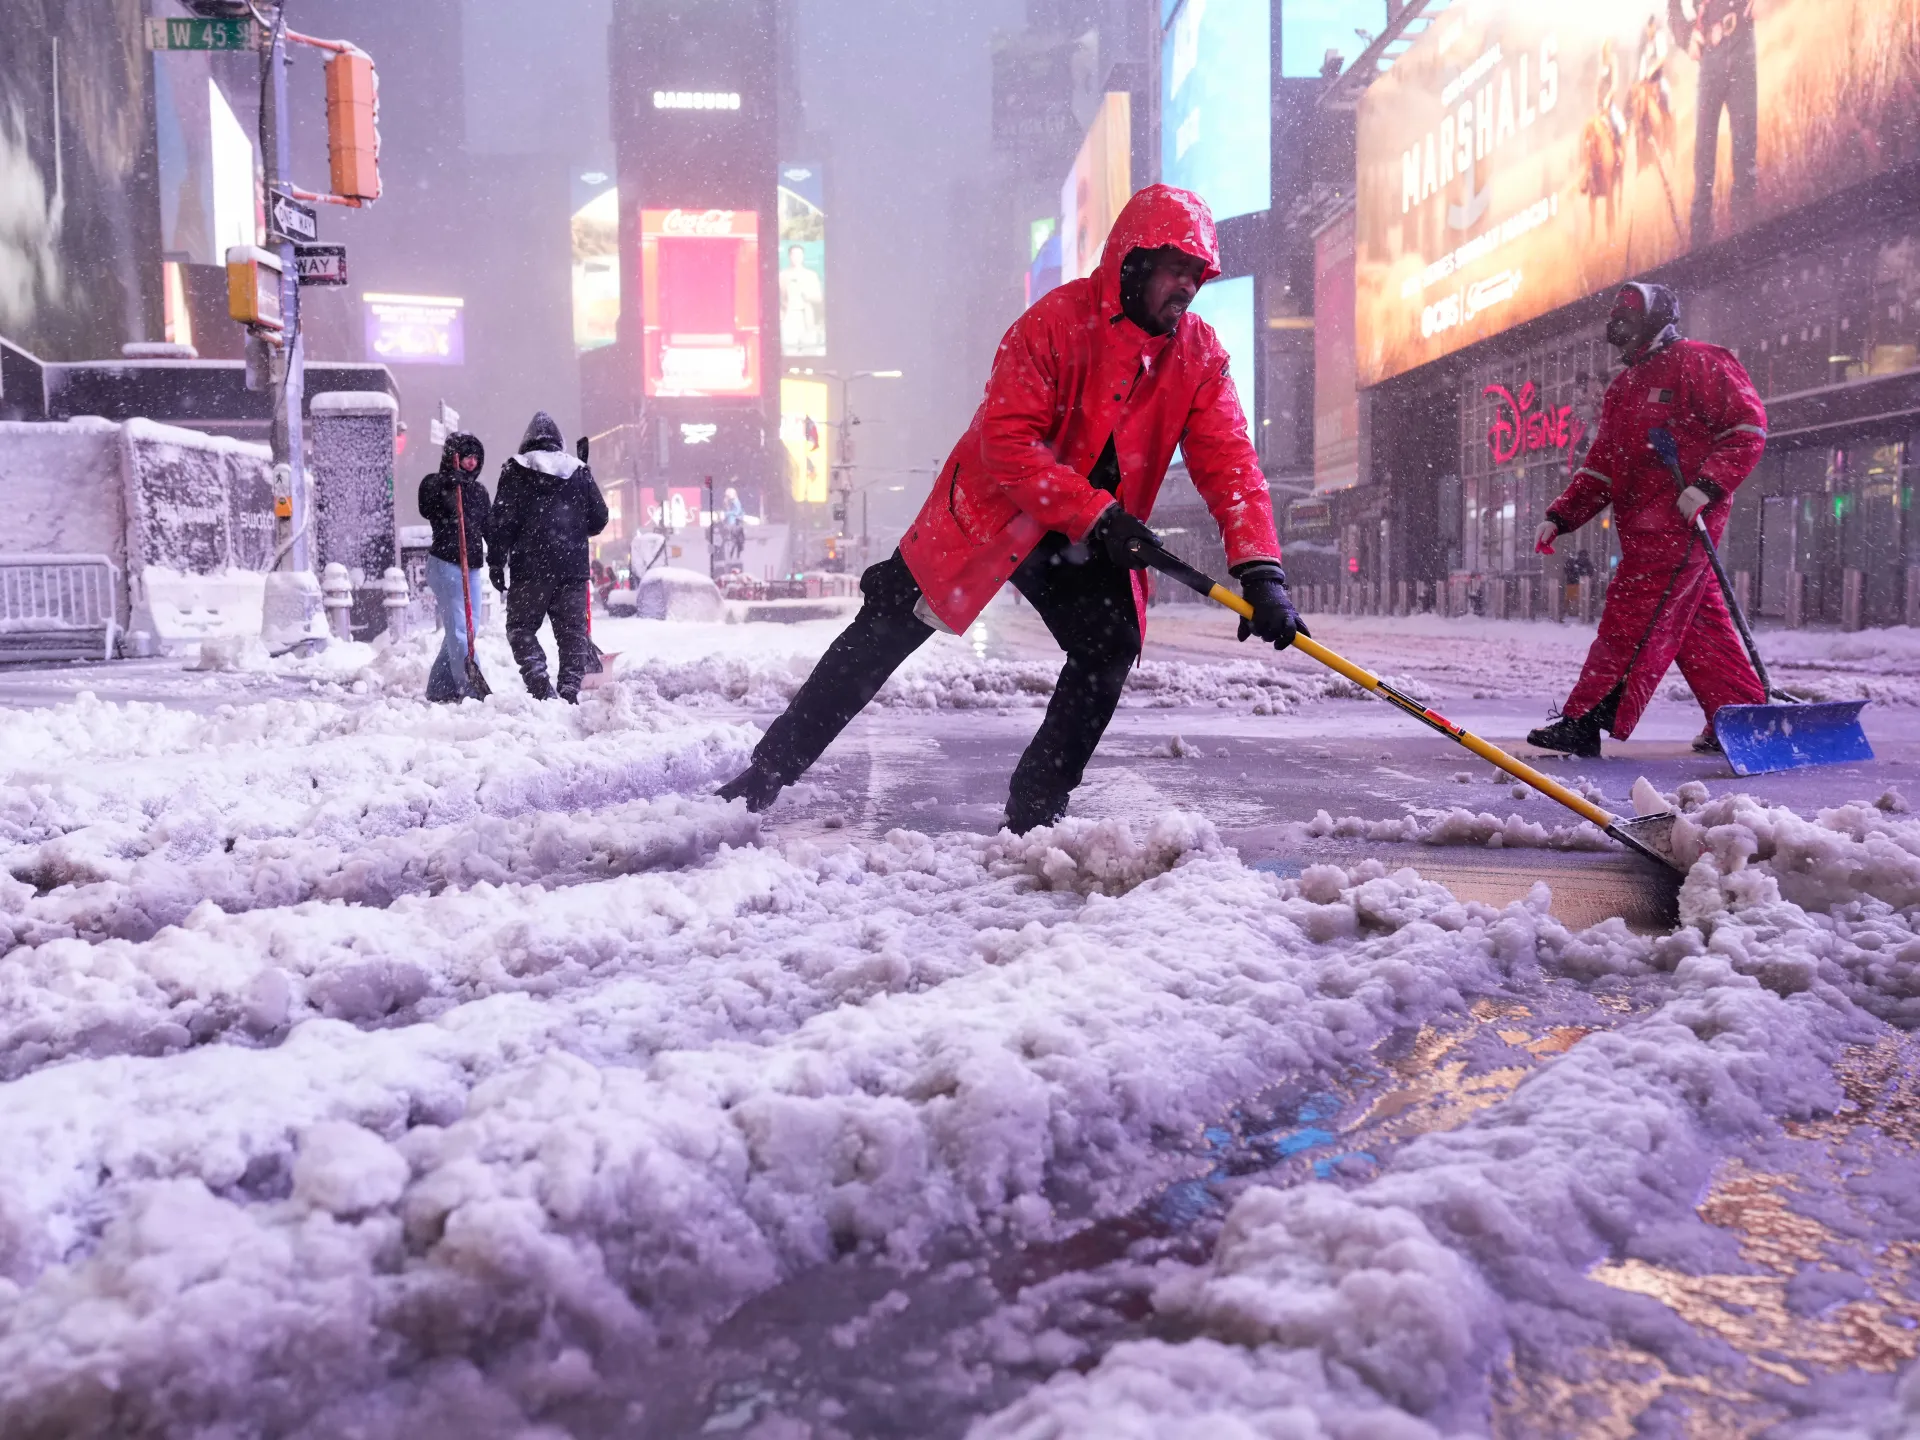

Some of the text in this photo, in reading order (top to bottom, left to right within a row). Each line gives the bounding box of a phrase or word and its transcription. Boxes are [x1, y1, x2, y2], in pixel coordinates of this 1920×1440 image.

[172, 22, 191, 47] W
[202, 22, 227, 47] 45
[1402, 31, 1558, 214] MARSHALS
